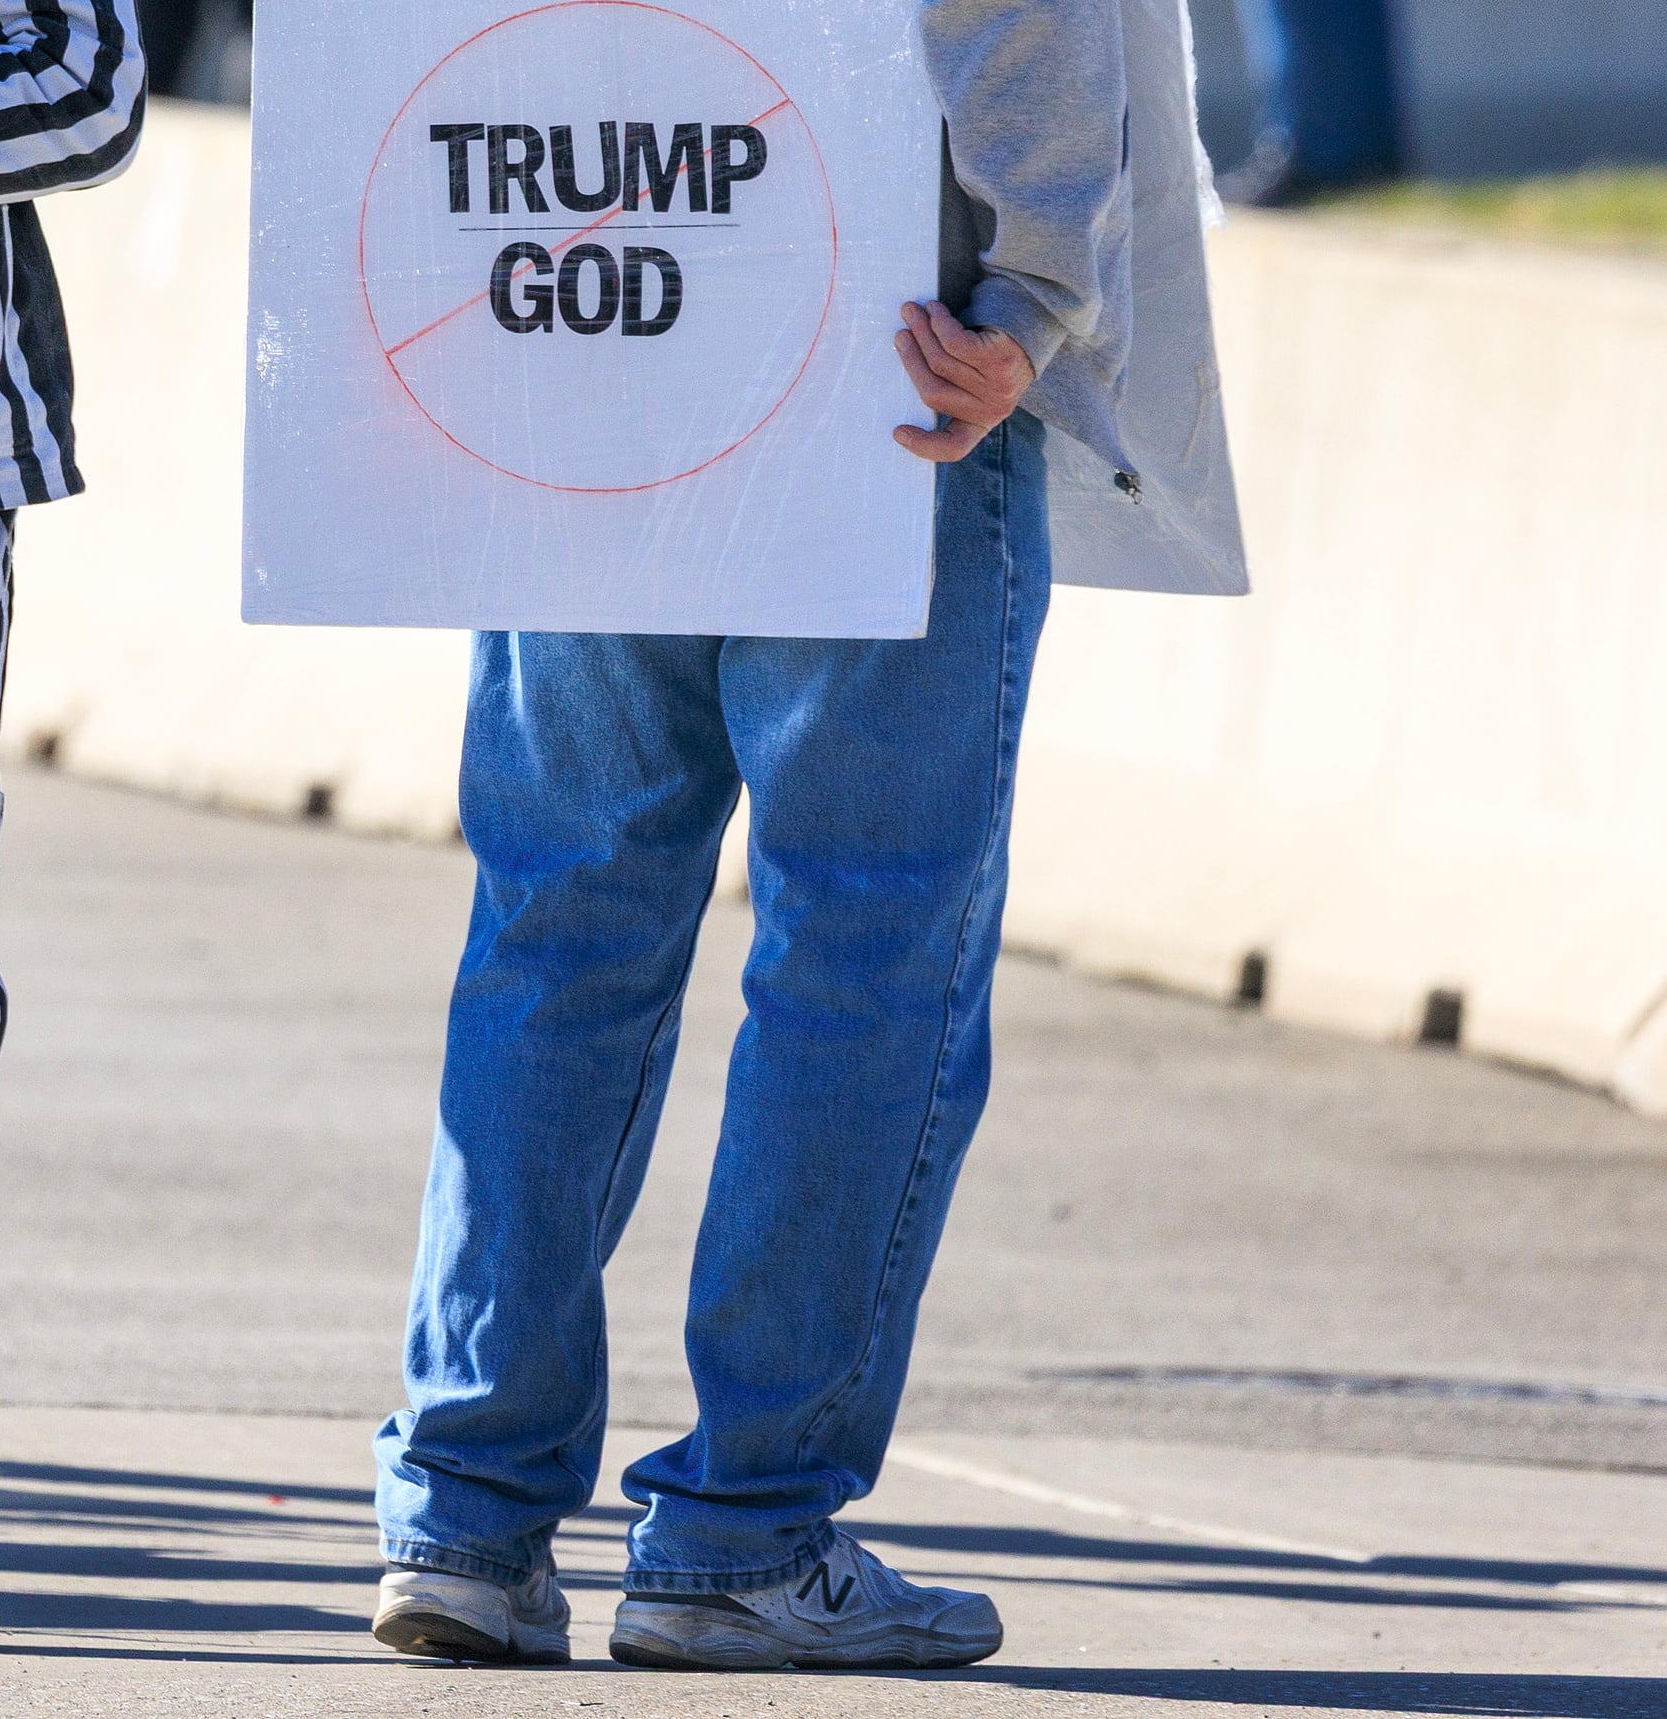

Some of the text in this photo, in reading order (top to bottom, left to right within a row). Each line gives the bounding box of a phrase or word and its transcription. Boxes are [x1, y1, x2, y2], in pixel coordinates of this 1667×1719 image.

[430, 120, 768, 215] TRUMP
[489, 241, 684, 337] GOD
[796, 1560, 857, 1614] N
